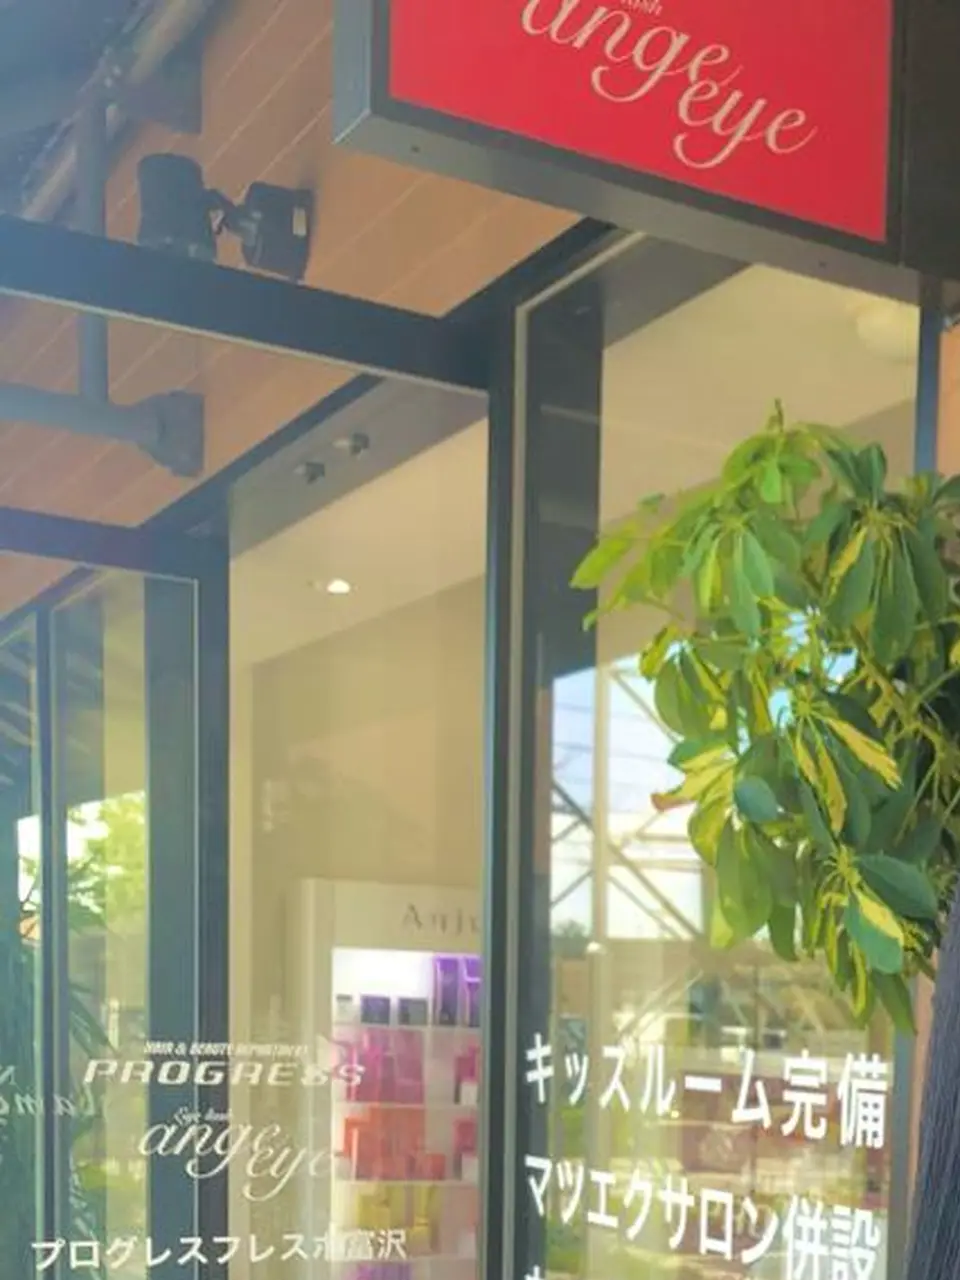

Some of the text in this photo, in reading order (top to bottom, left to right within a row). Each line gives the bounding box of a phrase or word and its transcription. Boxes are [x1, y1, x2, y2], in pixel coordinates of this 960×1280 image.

[672, 80, 818, 169] eye
[84, 1059, 366, 1087] PROGRESS
[525, 1033, 889, 1149] キッズルーム完備
